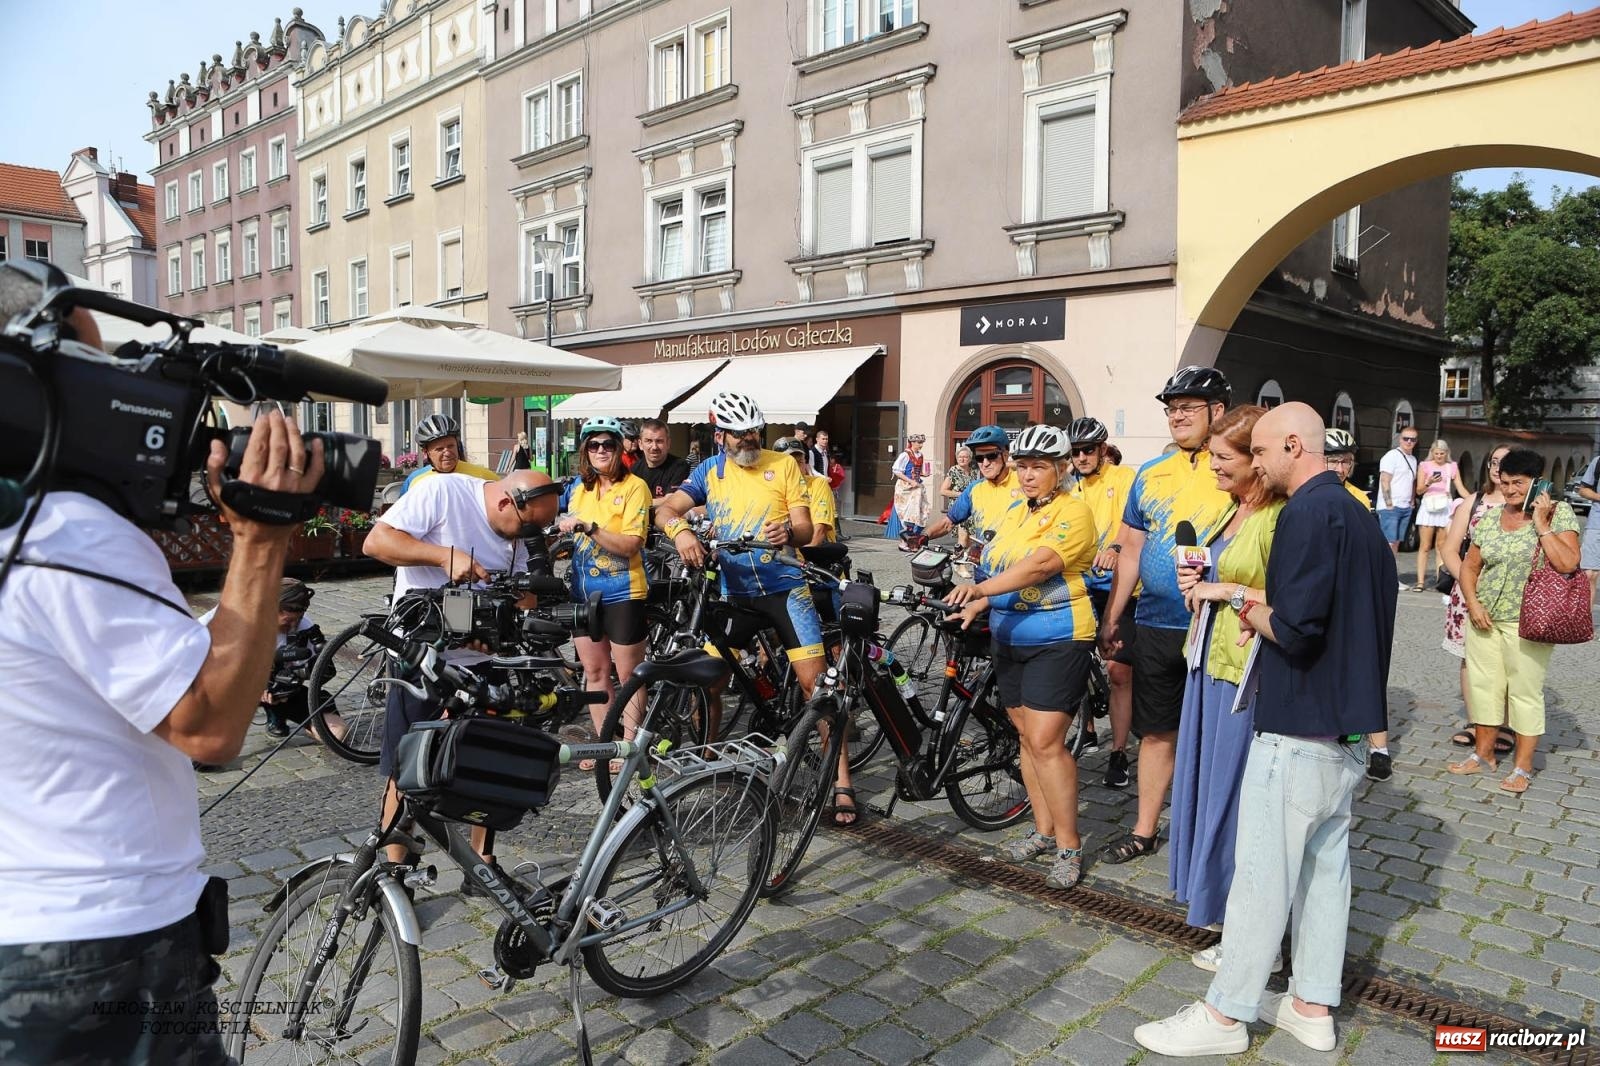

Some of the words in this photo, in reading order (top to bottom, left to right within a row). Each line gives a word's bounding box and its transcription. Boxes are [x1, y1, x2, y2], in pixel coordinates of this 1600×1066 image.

[995, 315, 1048, 328] MORAJ
[654, 334, 729, 358] Manufaktura
[733, 328, 781, 353] Lodów
[785, 320, 852, 347] Gałeczka
[111, 399, 173, 419] Panasonic
[145, 425, 165, 449] 6
[472, 863, 537, 927] GIANT
